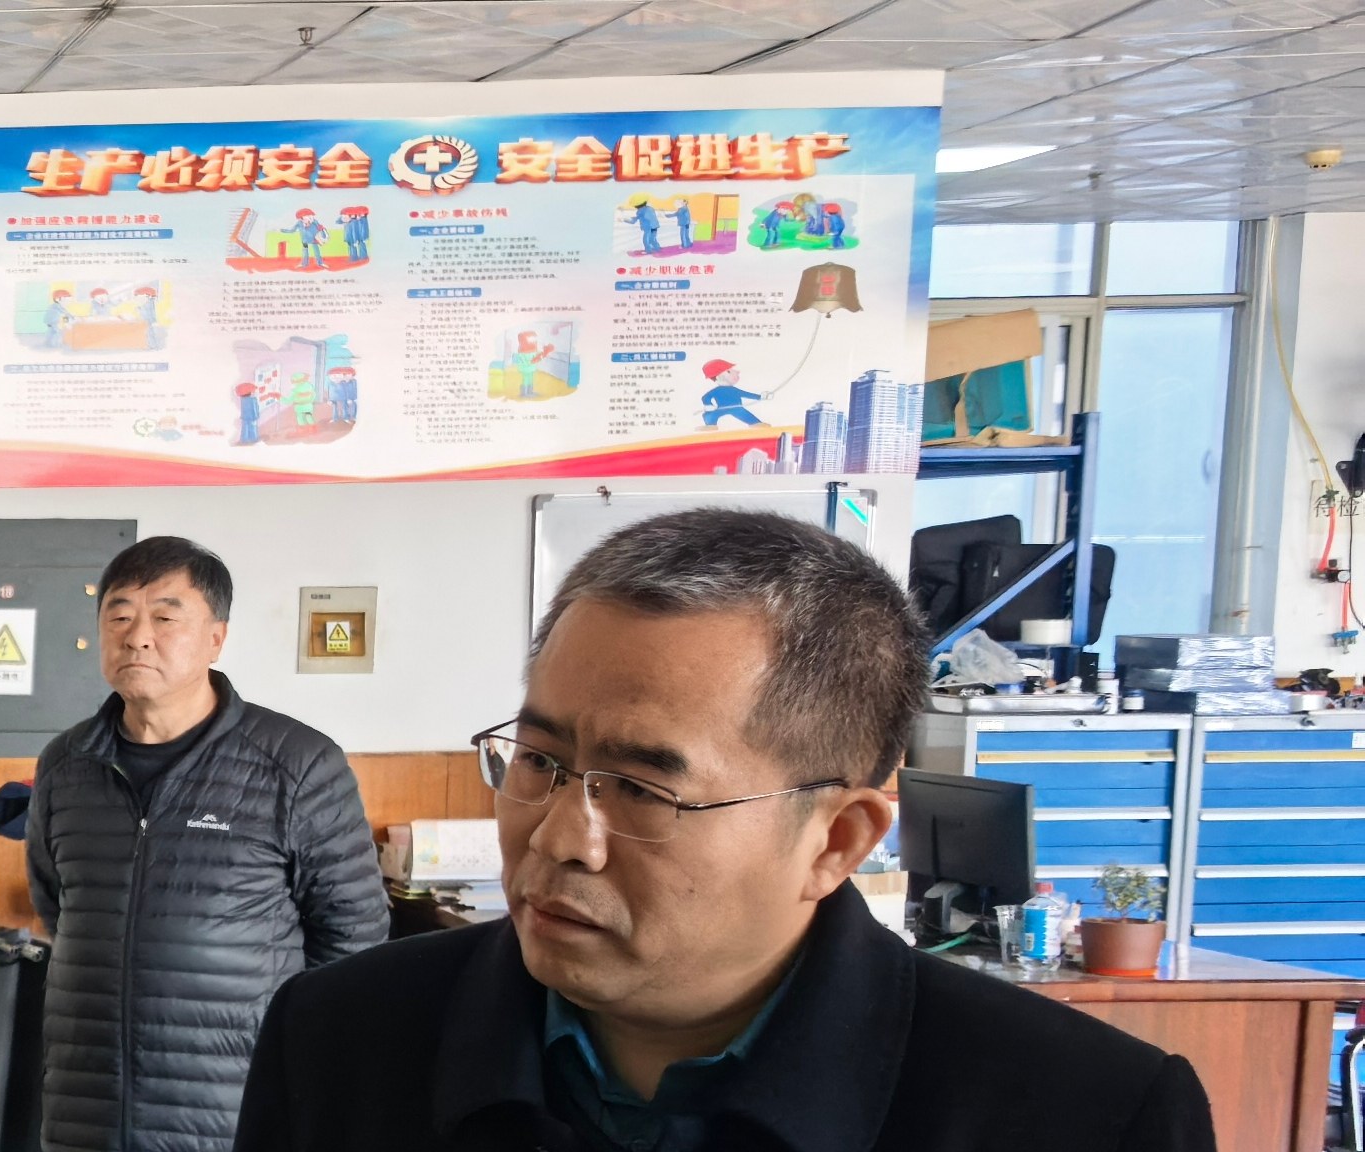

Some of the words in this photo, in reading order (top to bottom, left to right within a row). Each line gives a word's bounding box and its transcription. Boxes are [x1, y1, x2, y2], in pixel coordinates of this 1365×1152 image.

[21, 142, 372, 197] 生产必须安全
[496, 131, 857, 188] 安全促进生产
